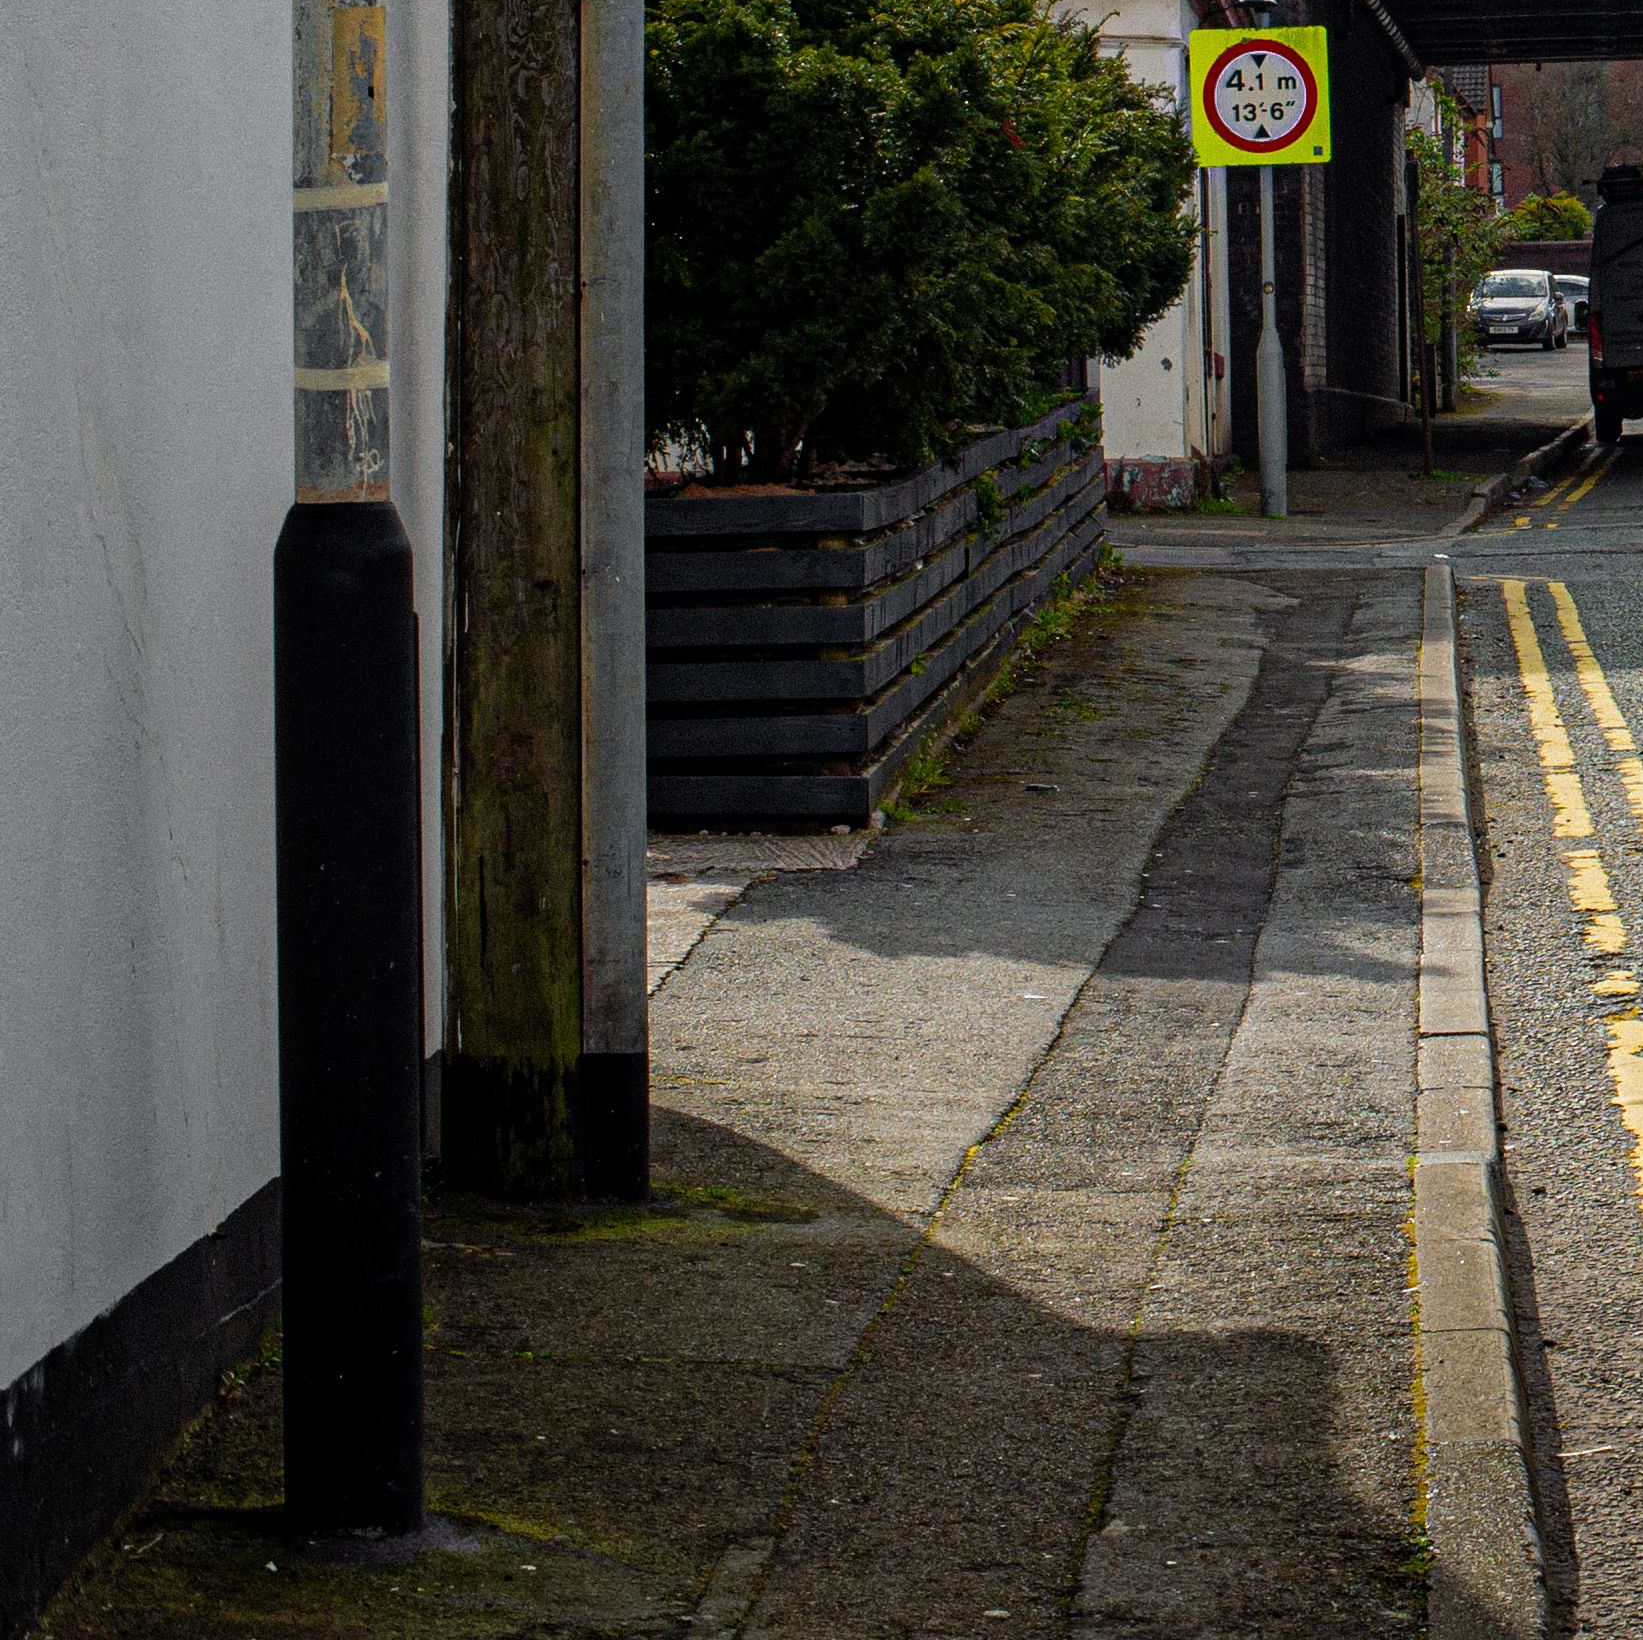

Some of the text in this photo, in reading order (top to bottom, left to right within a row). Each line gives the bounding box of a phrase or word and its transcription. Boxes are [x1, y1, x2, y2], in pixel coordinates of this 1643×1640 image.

[1225, 69, 1297, 92] 4.1 m
[1232, 100, 1296, 122] 13'-6"
